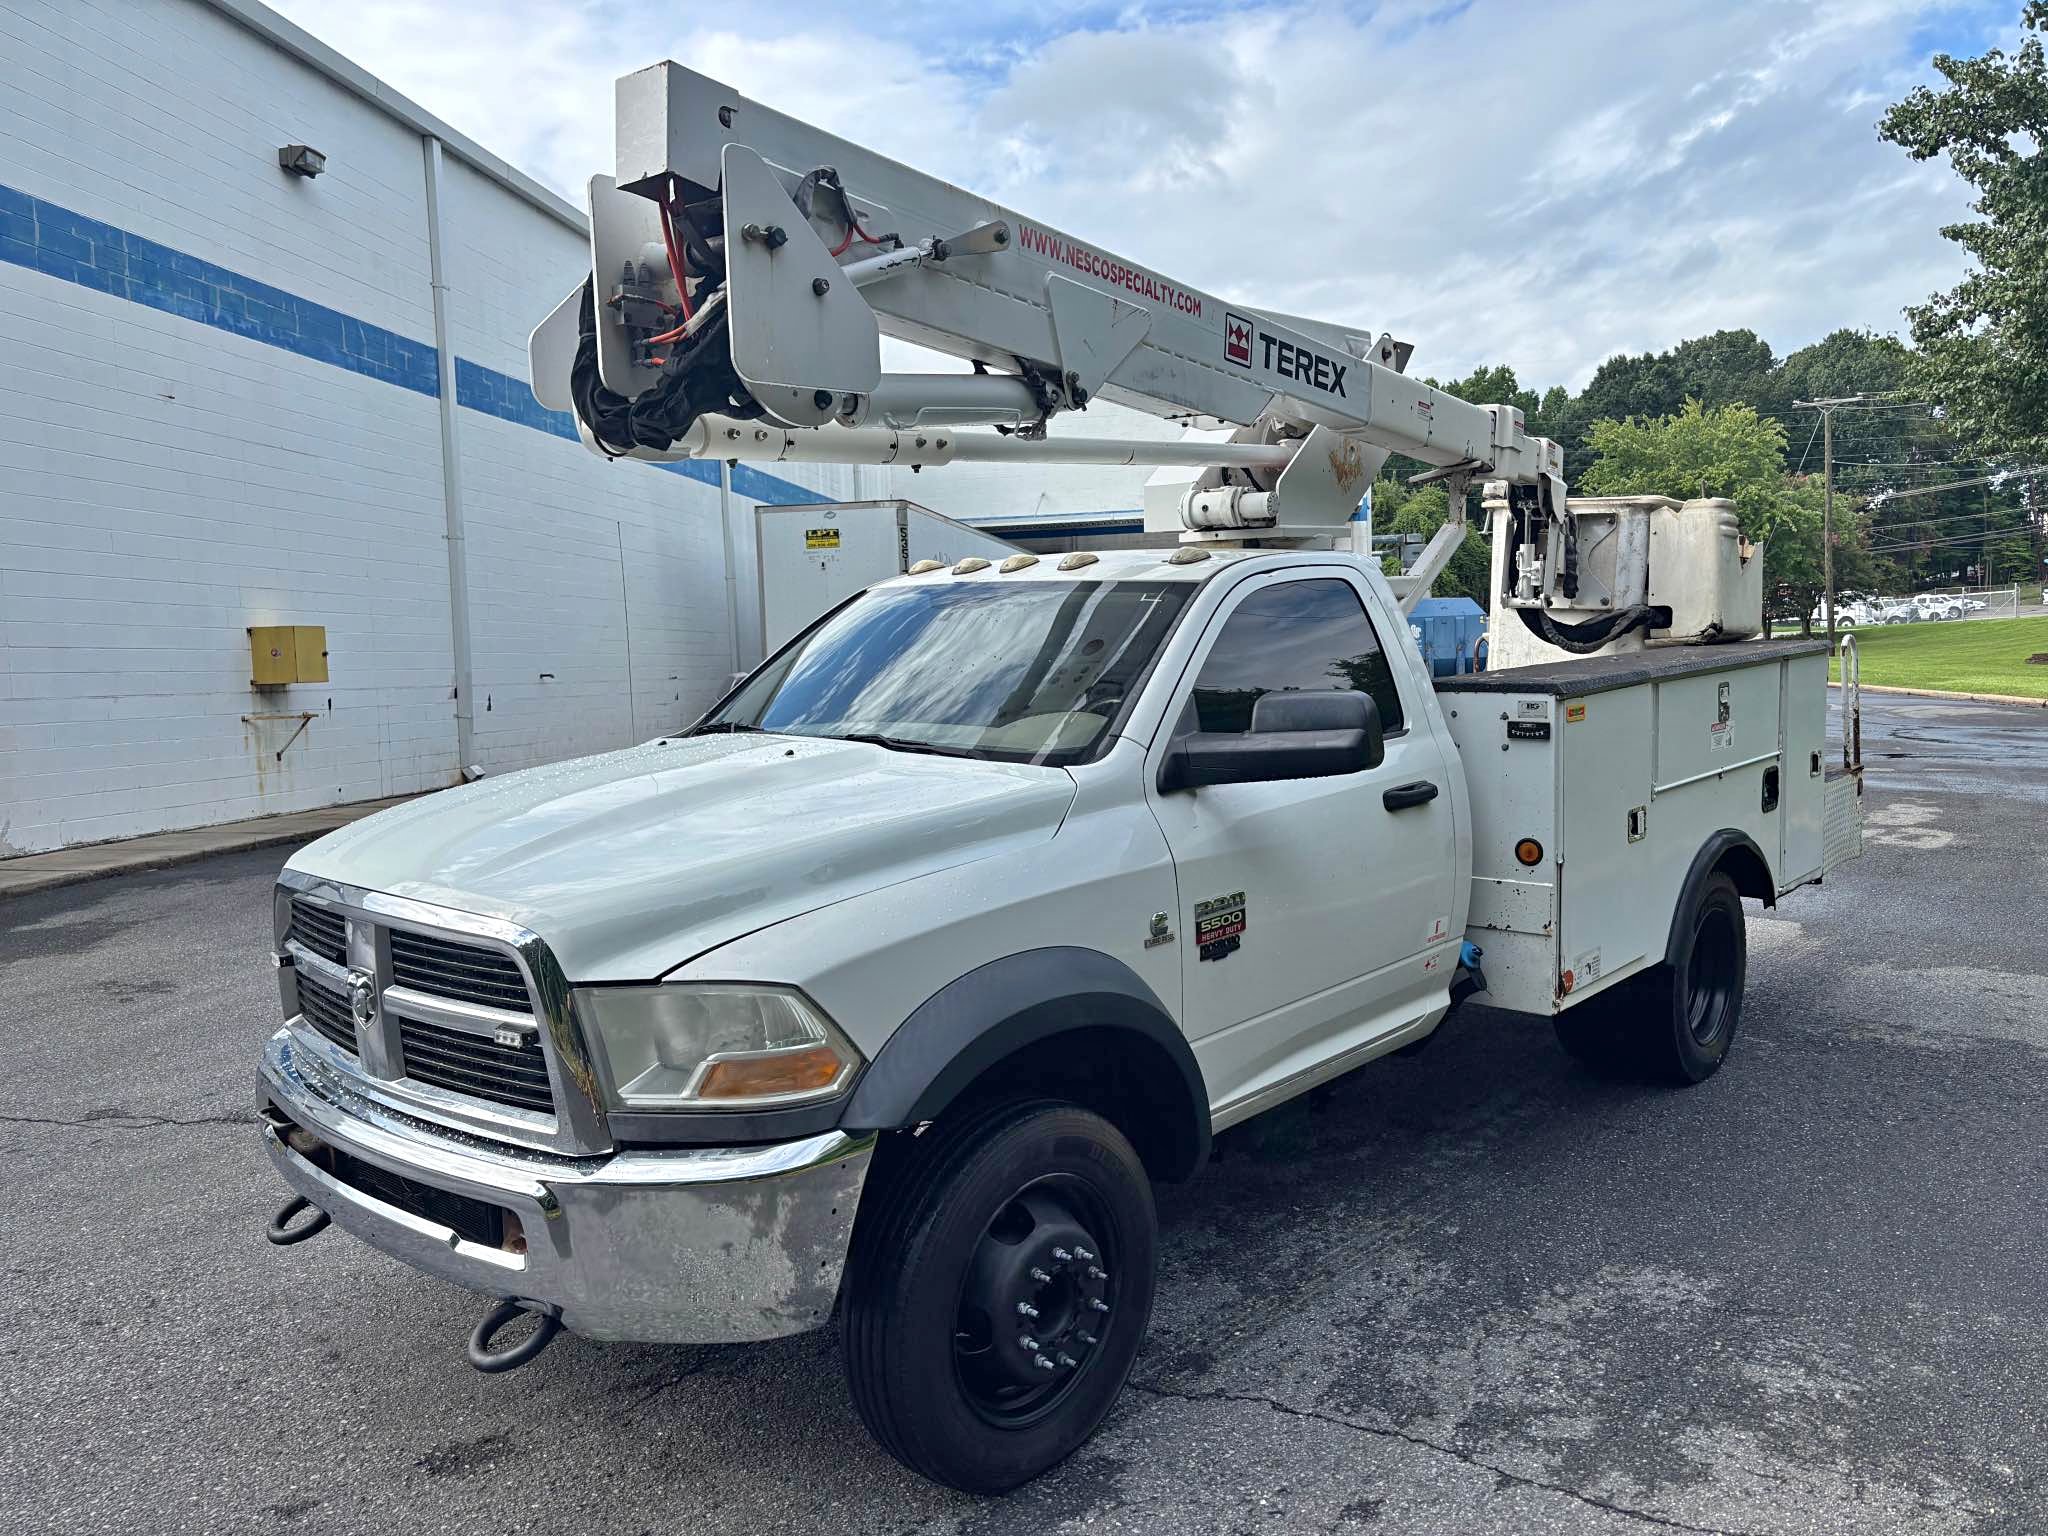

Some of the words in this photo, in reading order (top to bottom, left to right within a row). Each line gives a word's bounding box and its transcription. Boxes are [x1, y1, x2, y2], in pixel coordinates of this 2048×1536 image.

[1018, 223, 1201, 318] WWW.NESCOSPECIALTY.COM
[1258, 332, 1347, 398] TEREX
[1200, 911, 1242, 933] 5500
[1201, 929, 1224, 942] HEAVY
[1226, 923, 1242, 934] DUTY
